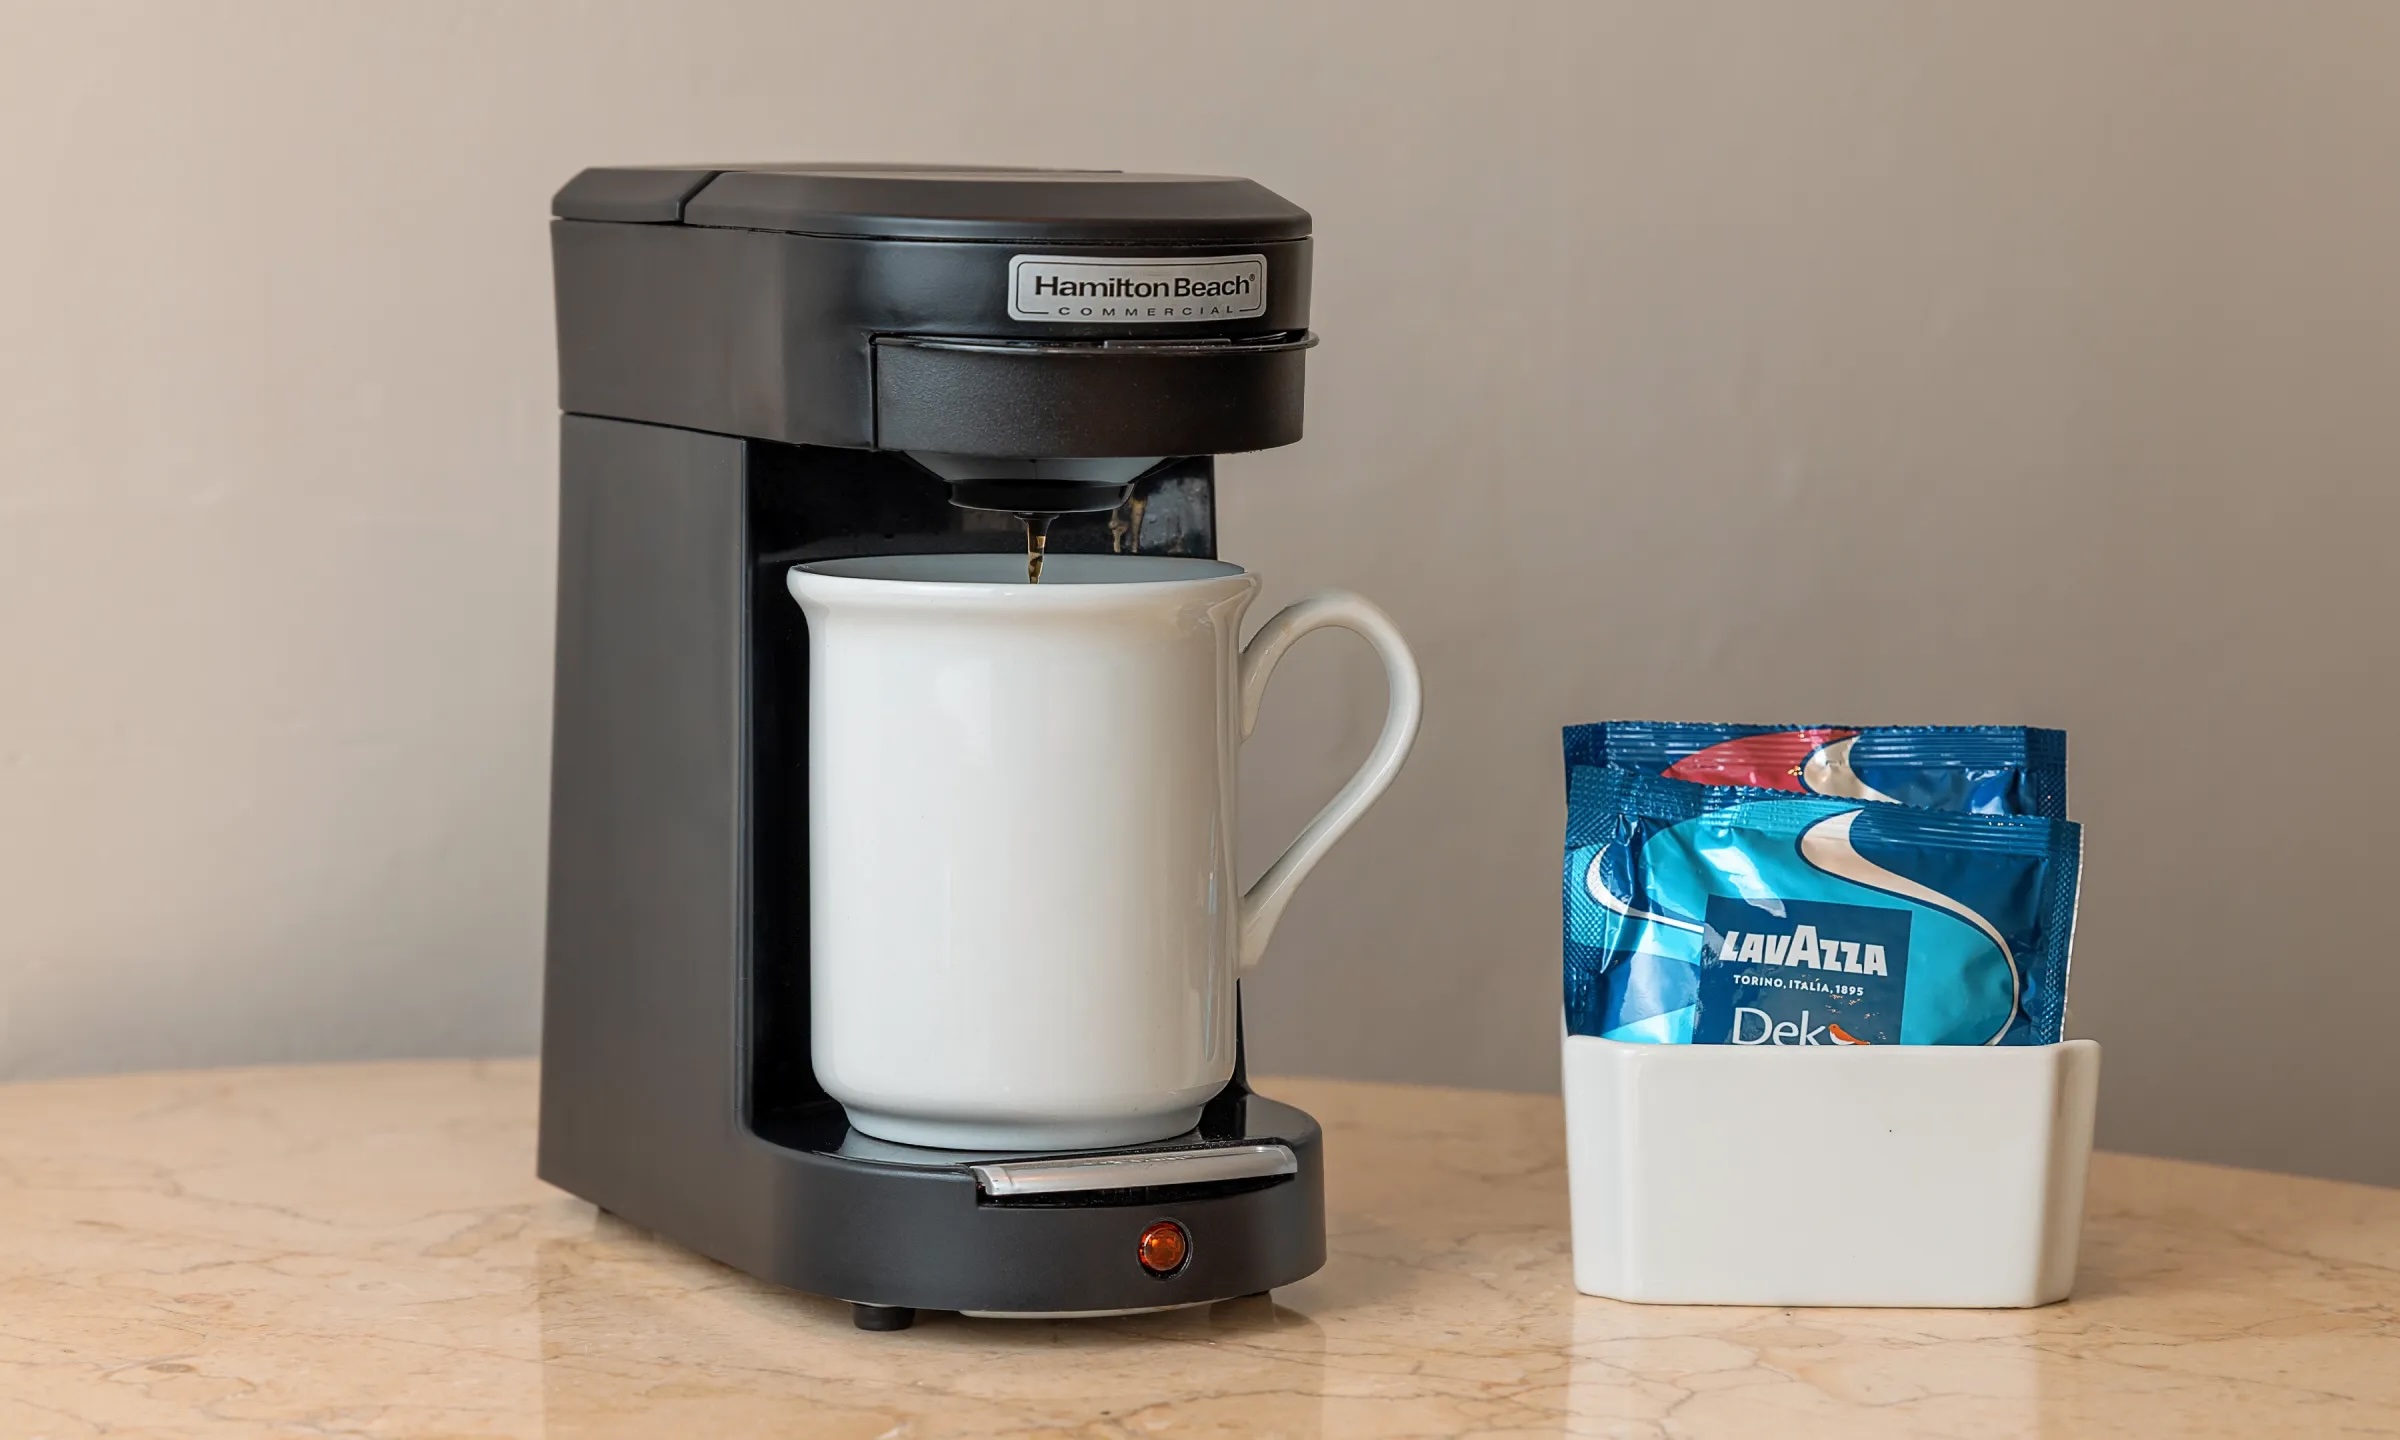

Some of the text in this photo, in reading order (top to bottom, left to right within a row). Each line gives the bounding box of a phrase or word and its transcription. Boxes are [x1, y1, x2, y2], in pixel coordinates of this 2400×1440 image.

[1035, 275, 1169, 298] Hamilton
[1058, 306, 1234, 316] COMMERCIAL
[1733, 975, 1787, 989] TORINO,
[1835, 984, 1864, 996] 1895
[1732, 1007, 1826, 1045] Dek
